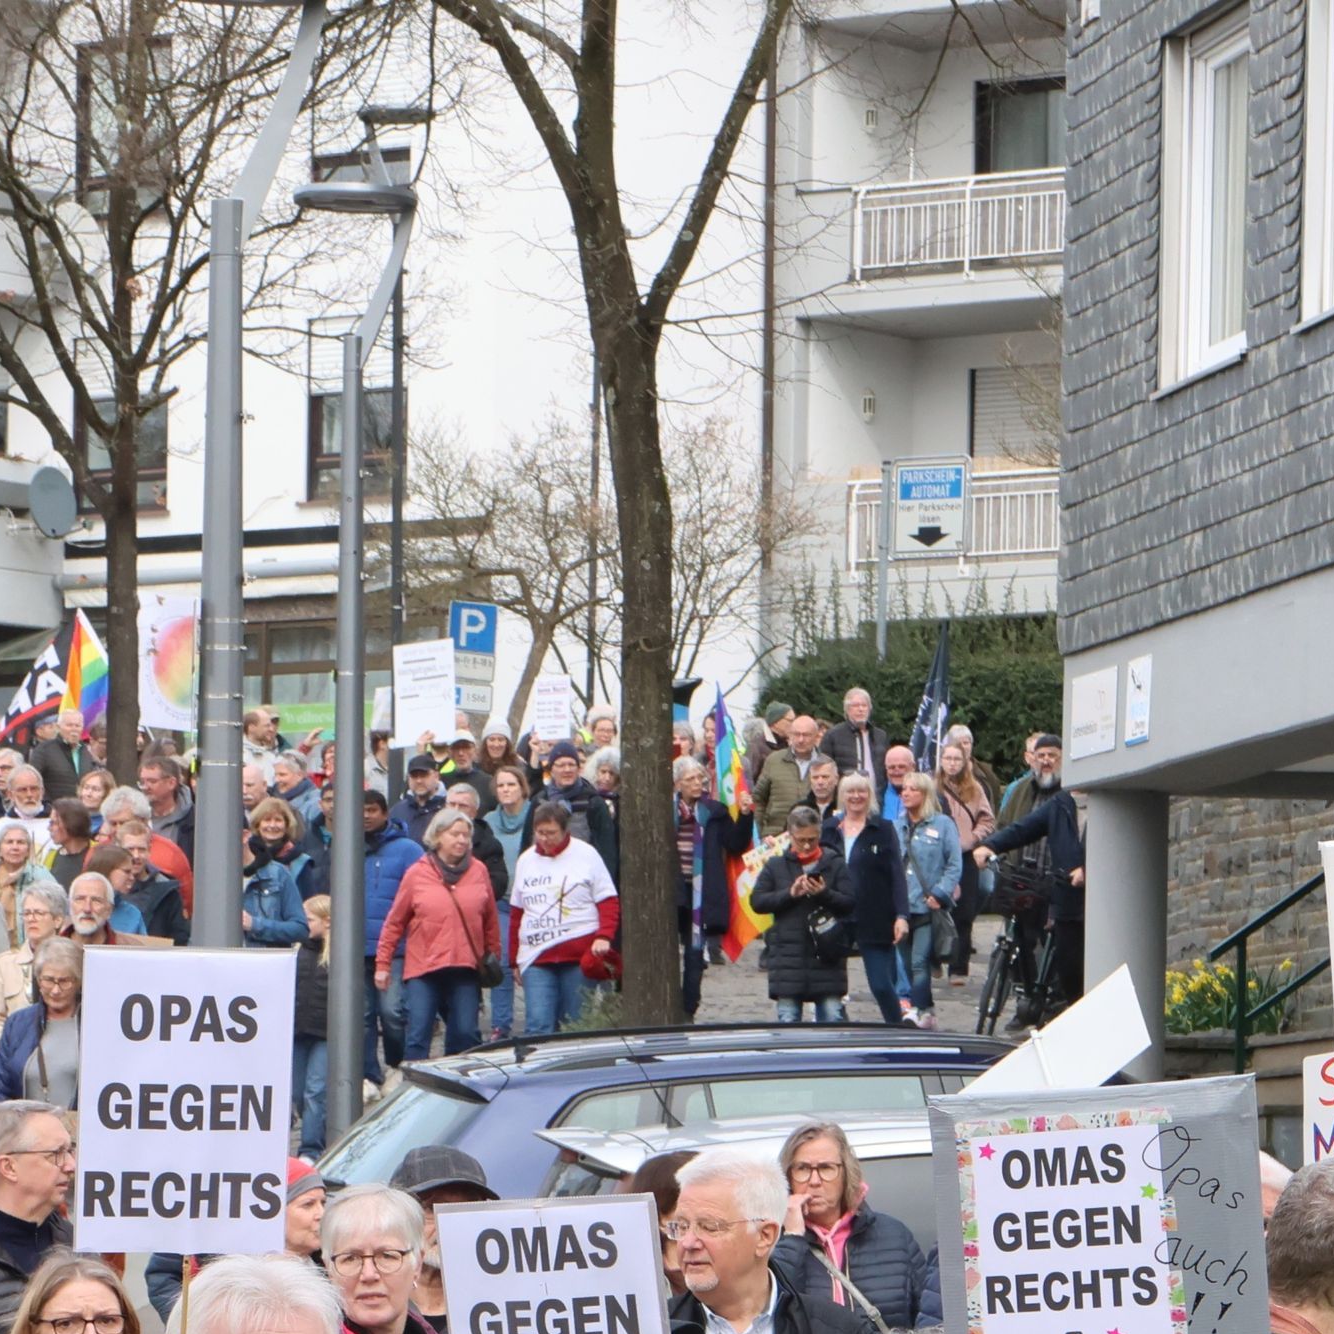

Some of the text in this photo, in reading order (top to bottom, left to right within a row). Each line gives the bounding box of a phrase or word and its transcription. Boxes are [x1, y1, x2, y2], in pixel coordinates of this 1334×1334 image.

[899, 502, 962, 512] Hier Parkschein
[910, 484, 951, 498] AUTOMAT
[459, 608, 486, 647] P
[523, 876, 552, 889] Kein
[526, 916, 556, 929] nach
[120, 994, 257, 1043] OPAS
[98, 1083, 272, 1131] GEGEN
[1002, 1144, 1125, 1189] OMAS
[1142, 1126, 1244, 1209] Opas
[83, 1171, 281, 1219] RECHTS
[476, 1222, 617, 1274] OMAS
[993, 1205, 1141, 1252] GEGEN
[1154, 1237, 1248, 1295] auch
[986, 1266, 1158, 1314] RECHTS
